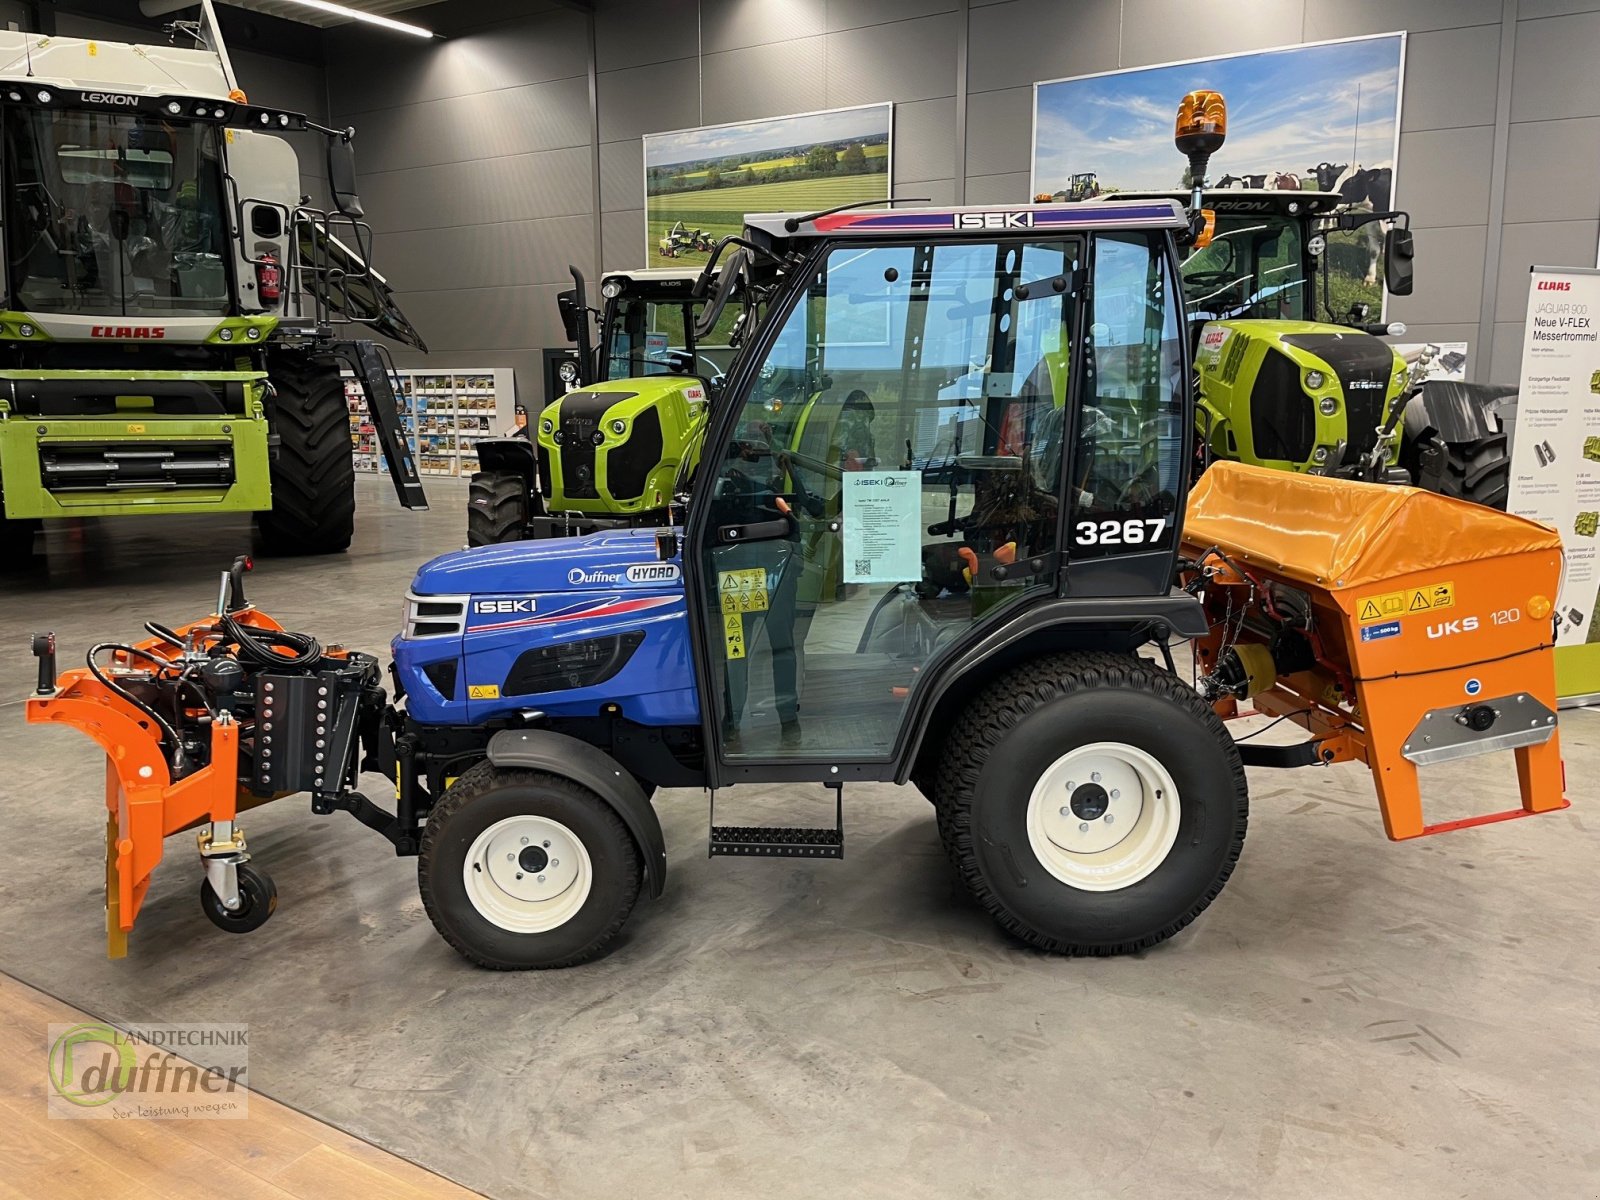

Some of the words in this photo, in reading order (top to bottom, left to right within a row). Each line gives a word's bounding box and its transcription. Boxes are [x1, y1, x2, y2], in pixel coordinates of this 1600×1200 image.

[81, 92, 139, 106] LEXION
[952, 211, 1035, 229] ISEKI
[1537, 281, 1571, 291] CLAAS
[1535, 303, 1570, 314] JAGUAR
[1571, 304, 1588, 315] 900
[1534, 317, 1557, 327] Neue
[1559, 317, 1591, 328] V-FLEX
[91, 326, 165, 338] CLAAS
[1205, 332, 1224, 344] CLAAS
[1533, 330, 1598, 342] Messertrommel
[687, 390, 702, 398] CLAAS
[1075, 518, 1167, 546] 3267
[567, 567, 622, 585] Duffner
[632, 566, 675, 580] HYDRO
[473, 599, 537, 615] ISEKI
[1426, 616, 1480, 639] UKS
[1489, 608, 1520, 626] 120
